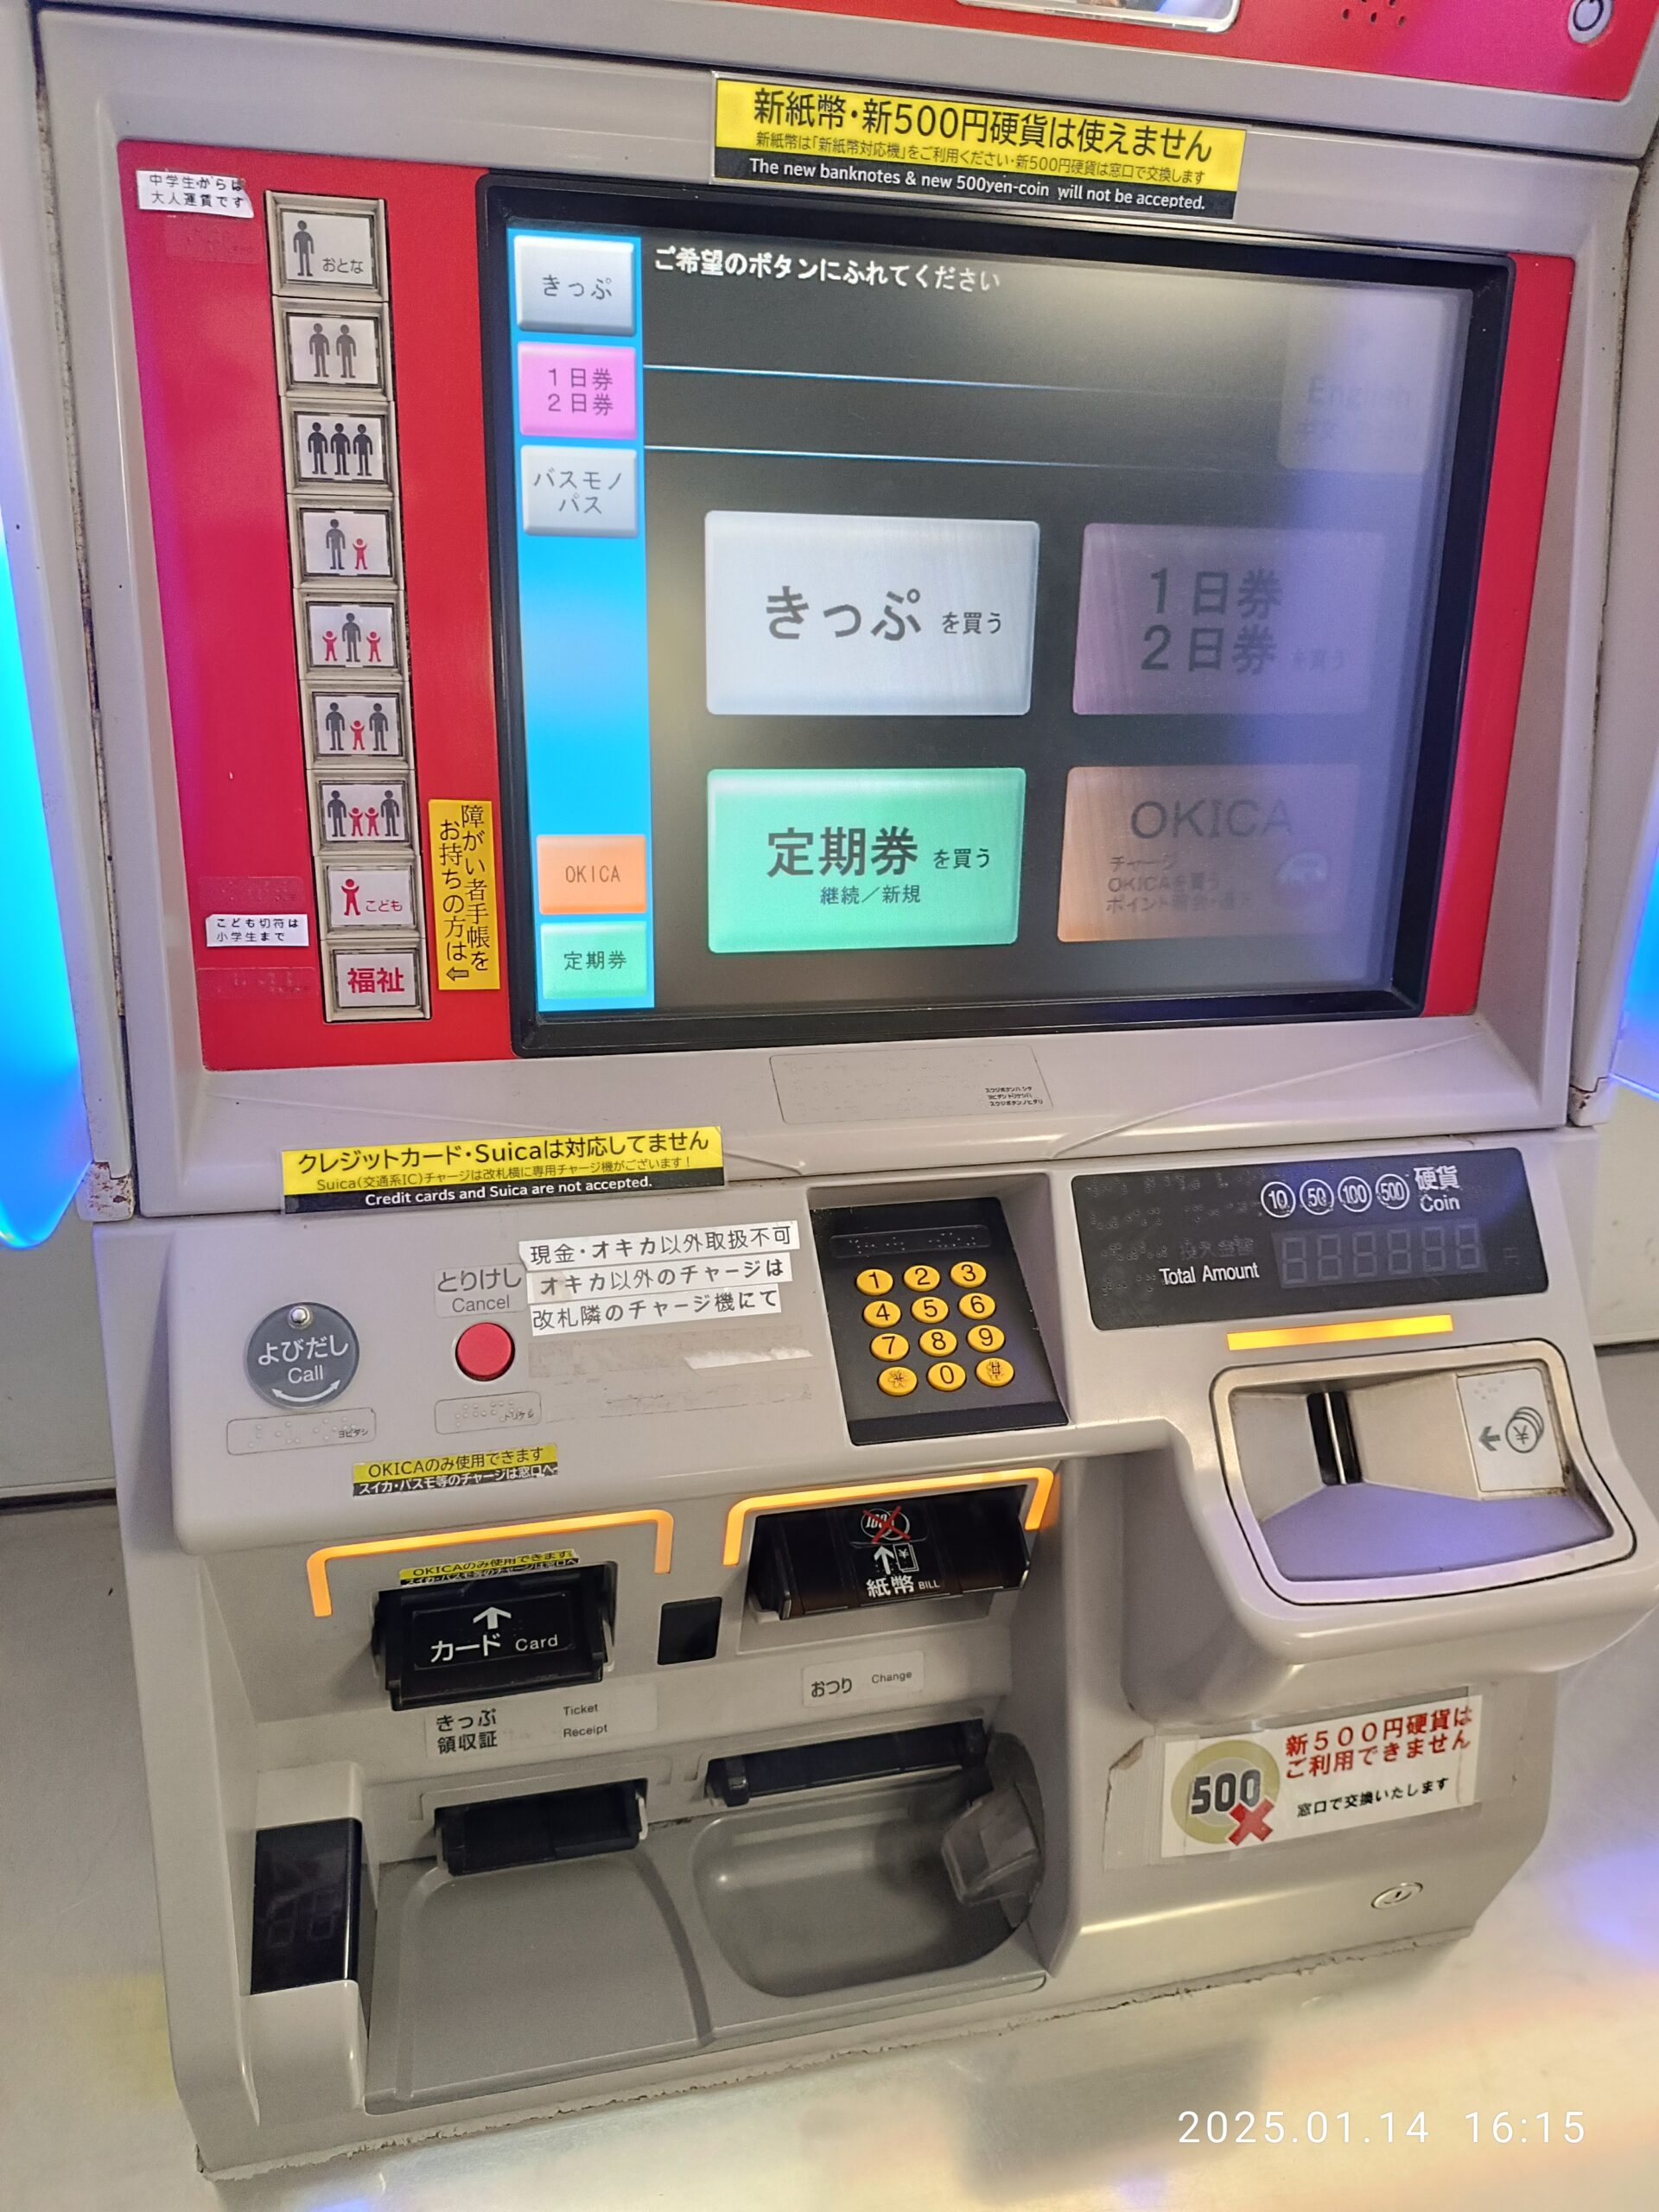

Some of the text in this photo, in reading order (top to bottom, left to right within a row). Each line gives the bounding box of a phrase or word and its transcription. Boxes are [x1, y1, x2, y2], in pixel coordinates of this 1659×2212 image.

[753, 87, 1212, 162] 新紙幣・新500円硬貨は使えません
[749, 158, 1206, 210] The new banknotes & new 500yen-coin will not be accepted.
[151, 190, 244, 208] 大人運賃です
[322, 257, 364, 275] おとな
[654, 247, 1001, 293] ご希望のボタンにふれてください
[541, 274, 613, 302] きっぷ
[547, 367, 613, 391] 1日券
[547, 392, 614, 416] 2日券
[533, 468, 622, 492] バスモノ
[558, 493, 603, 516] パス
[1150, 567, 1283, 620] 1日券
[766, 586, 1002, 641] きっぷ を買う
[1141, 624, 1278, 675] 2日券
[1130, 798, 1293, 840] OKICA
[767, 825, 991, 877] 定期券 を買う
[566, 864, 621, 883] OKICA
[439, 819, 467, 961] お持ちの方は
[461, 804, 490, 971] 障がい者手帳を
[820, 885, 921, 906] 継続／新規
[365, 899, 403, 912] こども
[216, 918, 298, 929] こども切符は
[216, 931, 285, 942] 小学生まで
[563, 950, 627, 970] 定期券
[347, 967, 405, 994] 福祉
[299, 1130, 709, 1174] クレジットカード・Suicaは対応してません
[365, 1176, 652, 1206] Credit cards and Suica are not accepted.
[1414, 1166, 1460, 1191] 硬貨
[1268, 1181, 1404, 1210] 10 50 100 500
[1420, 1194, 1460, 1213] Coin
[530, 1225, 791, 1265] 現金・オキカ以外取扱不可
[437, 1267, 522, 1294] とりけし
[540, 1258, 784, 1294] オキカ以外のチャージは
[868, 1264, 976, 1289] 1 2 3
[1159, 1262, 1260, 1286] Total Amount
[452, 1294, 510, 1313] Cancel
[532, 1289, 778, 1331] 改札隣のチャージ機にて
[875, 1295, 985, 1321] 4 5 6
[258, 1334, 349, 1365] よびだし
[881, 1328, 994, 1354] 7 8 9
[288, 1365, 323, 1384] Call
[939, 1365, 955, 1384] 0
[368, 1446, 543, 1478] OKICAのみ使用できます
[413, 1551, 570, 1576] OKICAのみ使用できます
[866, 1575, 940, 1598] 紙幣 BILL
[430, 1633, 558, 1663] カード Card
[811, 1670, 912, 1698] おつり Change
[436, 1708, 497, 1732] きっぷ
[563, 1703, 599, 1717] Ticket
[437, 1732, 499, 1755] 領収証
[563, 1724, 608, 1738] Receipt
[1286, 1706, 1472, 1756] 新500円硬貨は
[1286, 1730, 1471, 1779] ご利用できません
[1191, 1769, 1261, 1815] 500
[1297, 1777, 1449, 1818] 窓口で交換いたします
